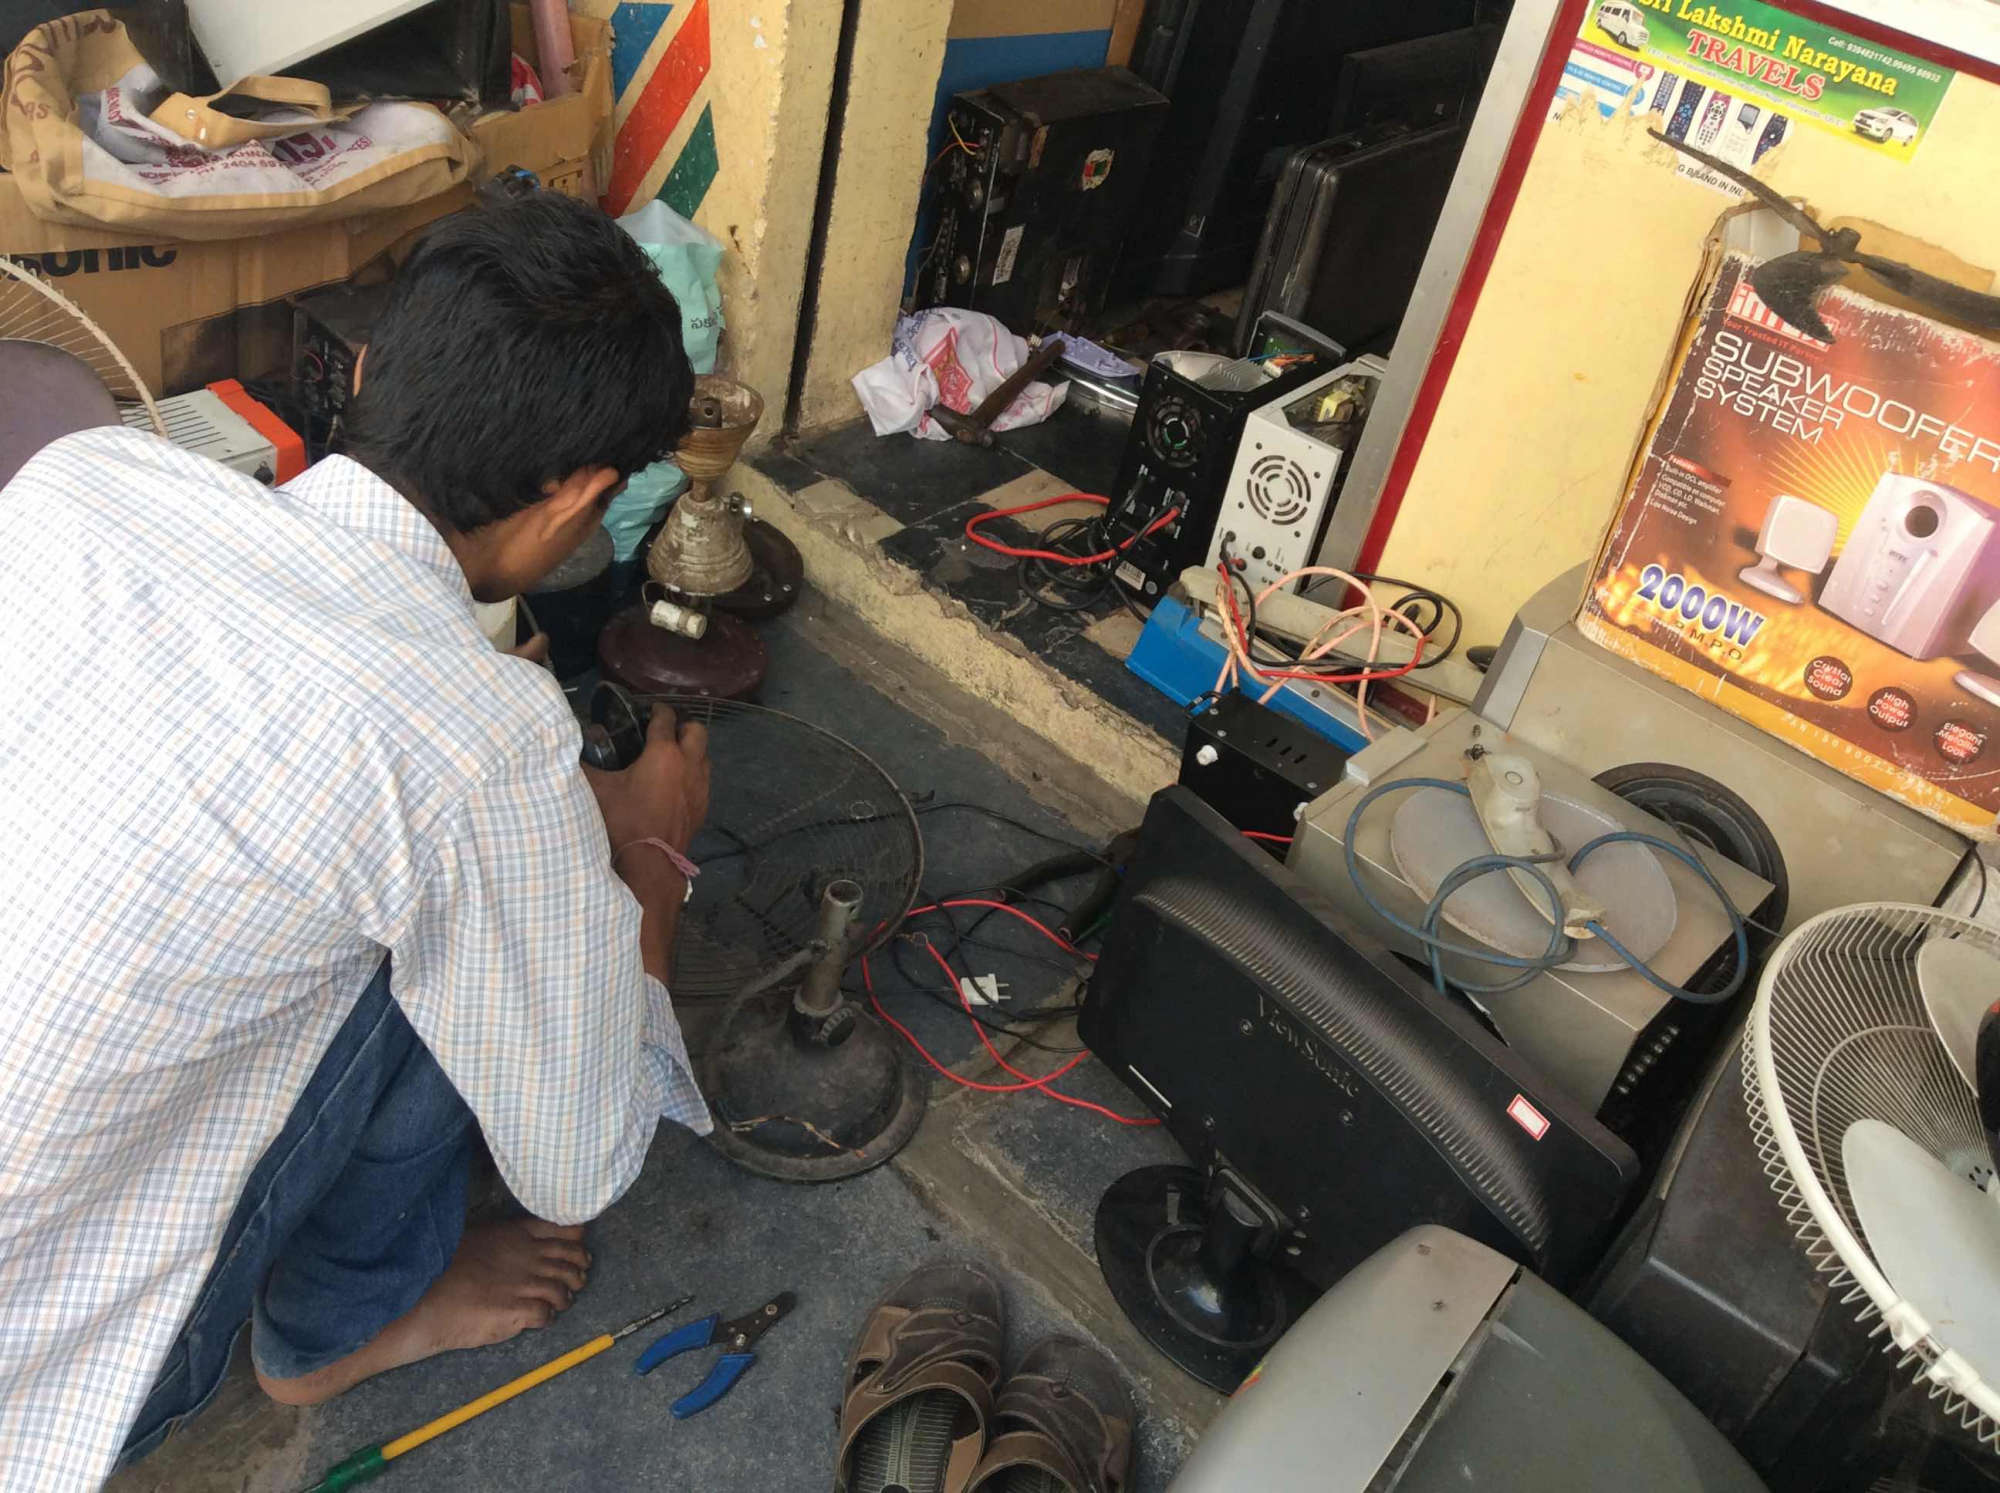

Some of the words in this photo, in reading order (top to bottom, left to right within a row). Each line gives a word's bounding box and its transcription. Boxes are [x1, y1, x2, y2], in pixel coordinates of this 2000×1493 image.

[1677, 0, 1780, 51] Lakshmi
[1782, 35, 1898, 96] Narayana
[1687, 29, 1825, 101] TRAVELS
[1686, 167, 1718, 186] BRAND
[1718, 179, 1729, 191] IN
[1702, 356, 1845, 430] SPEAKER
[1711, 331, 2000, 474] SUBWOOFER
[1694, 376, 1824, 445] SYSTEM
[1637, 565, 1764, 647] 2000W
[1813, 660, 1851, 684] Crystal
[1813, 668, 1844, 687] Clear
[1875, 698, 1910, 719] Power
[1883, 692, 1909, 710] High
[1869, 705, 1909, 728] Output
[1943, 722, 1983, 746] Elegant
[1942, 741, 1967, 759] Look
